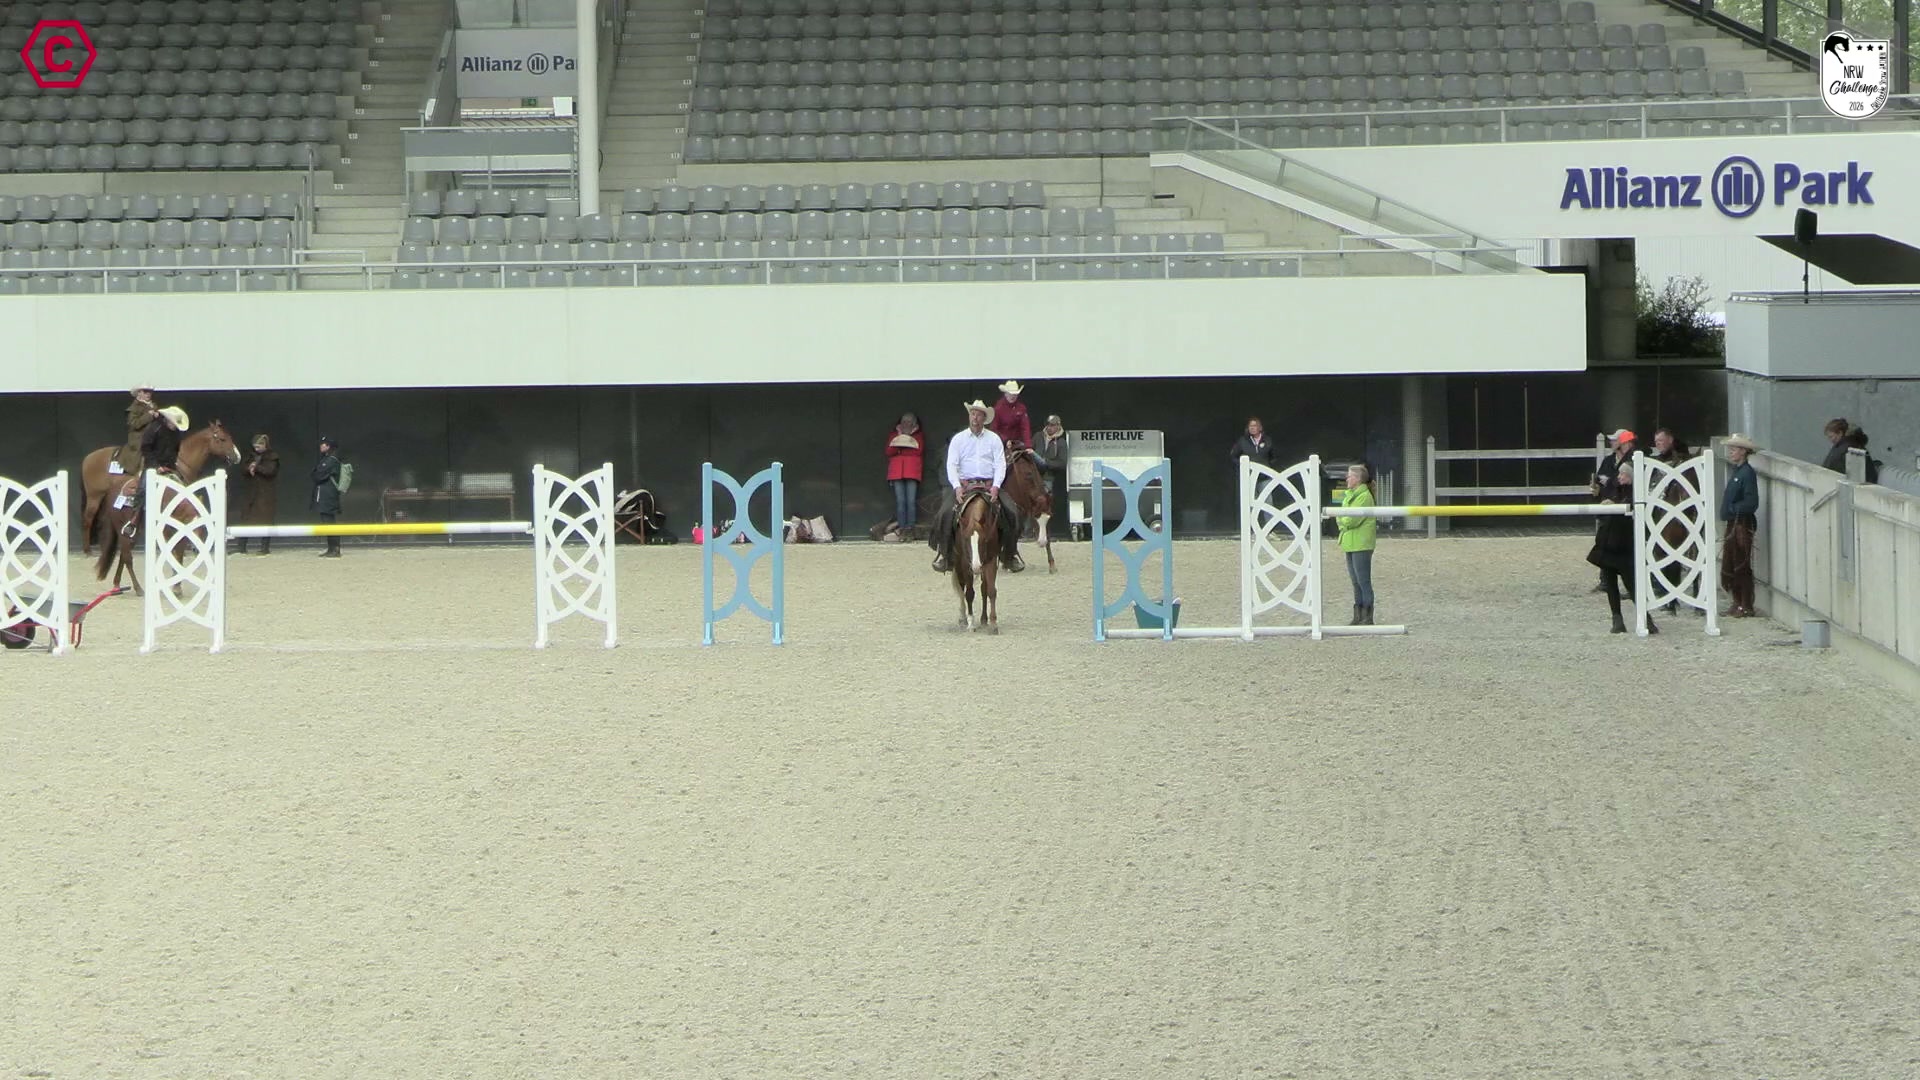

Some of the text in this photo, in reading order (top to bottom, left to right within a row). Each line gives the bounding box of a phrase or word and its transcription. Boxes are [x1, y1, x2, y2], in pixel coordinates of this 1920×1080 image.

[461, 56, 522, 72] Allianz
[1560, 161, 1875, 209] Allianz Park
[1081, 431, 1144, 441] REITERLIVE
